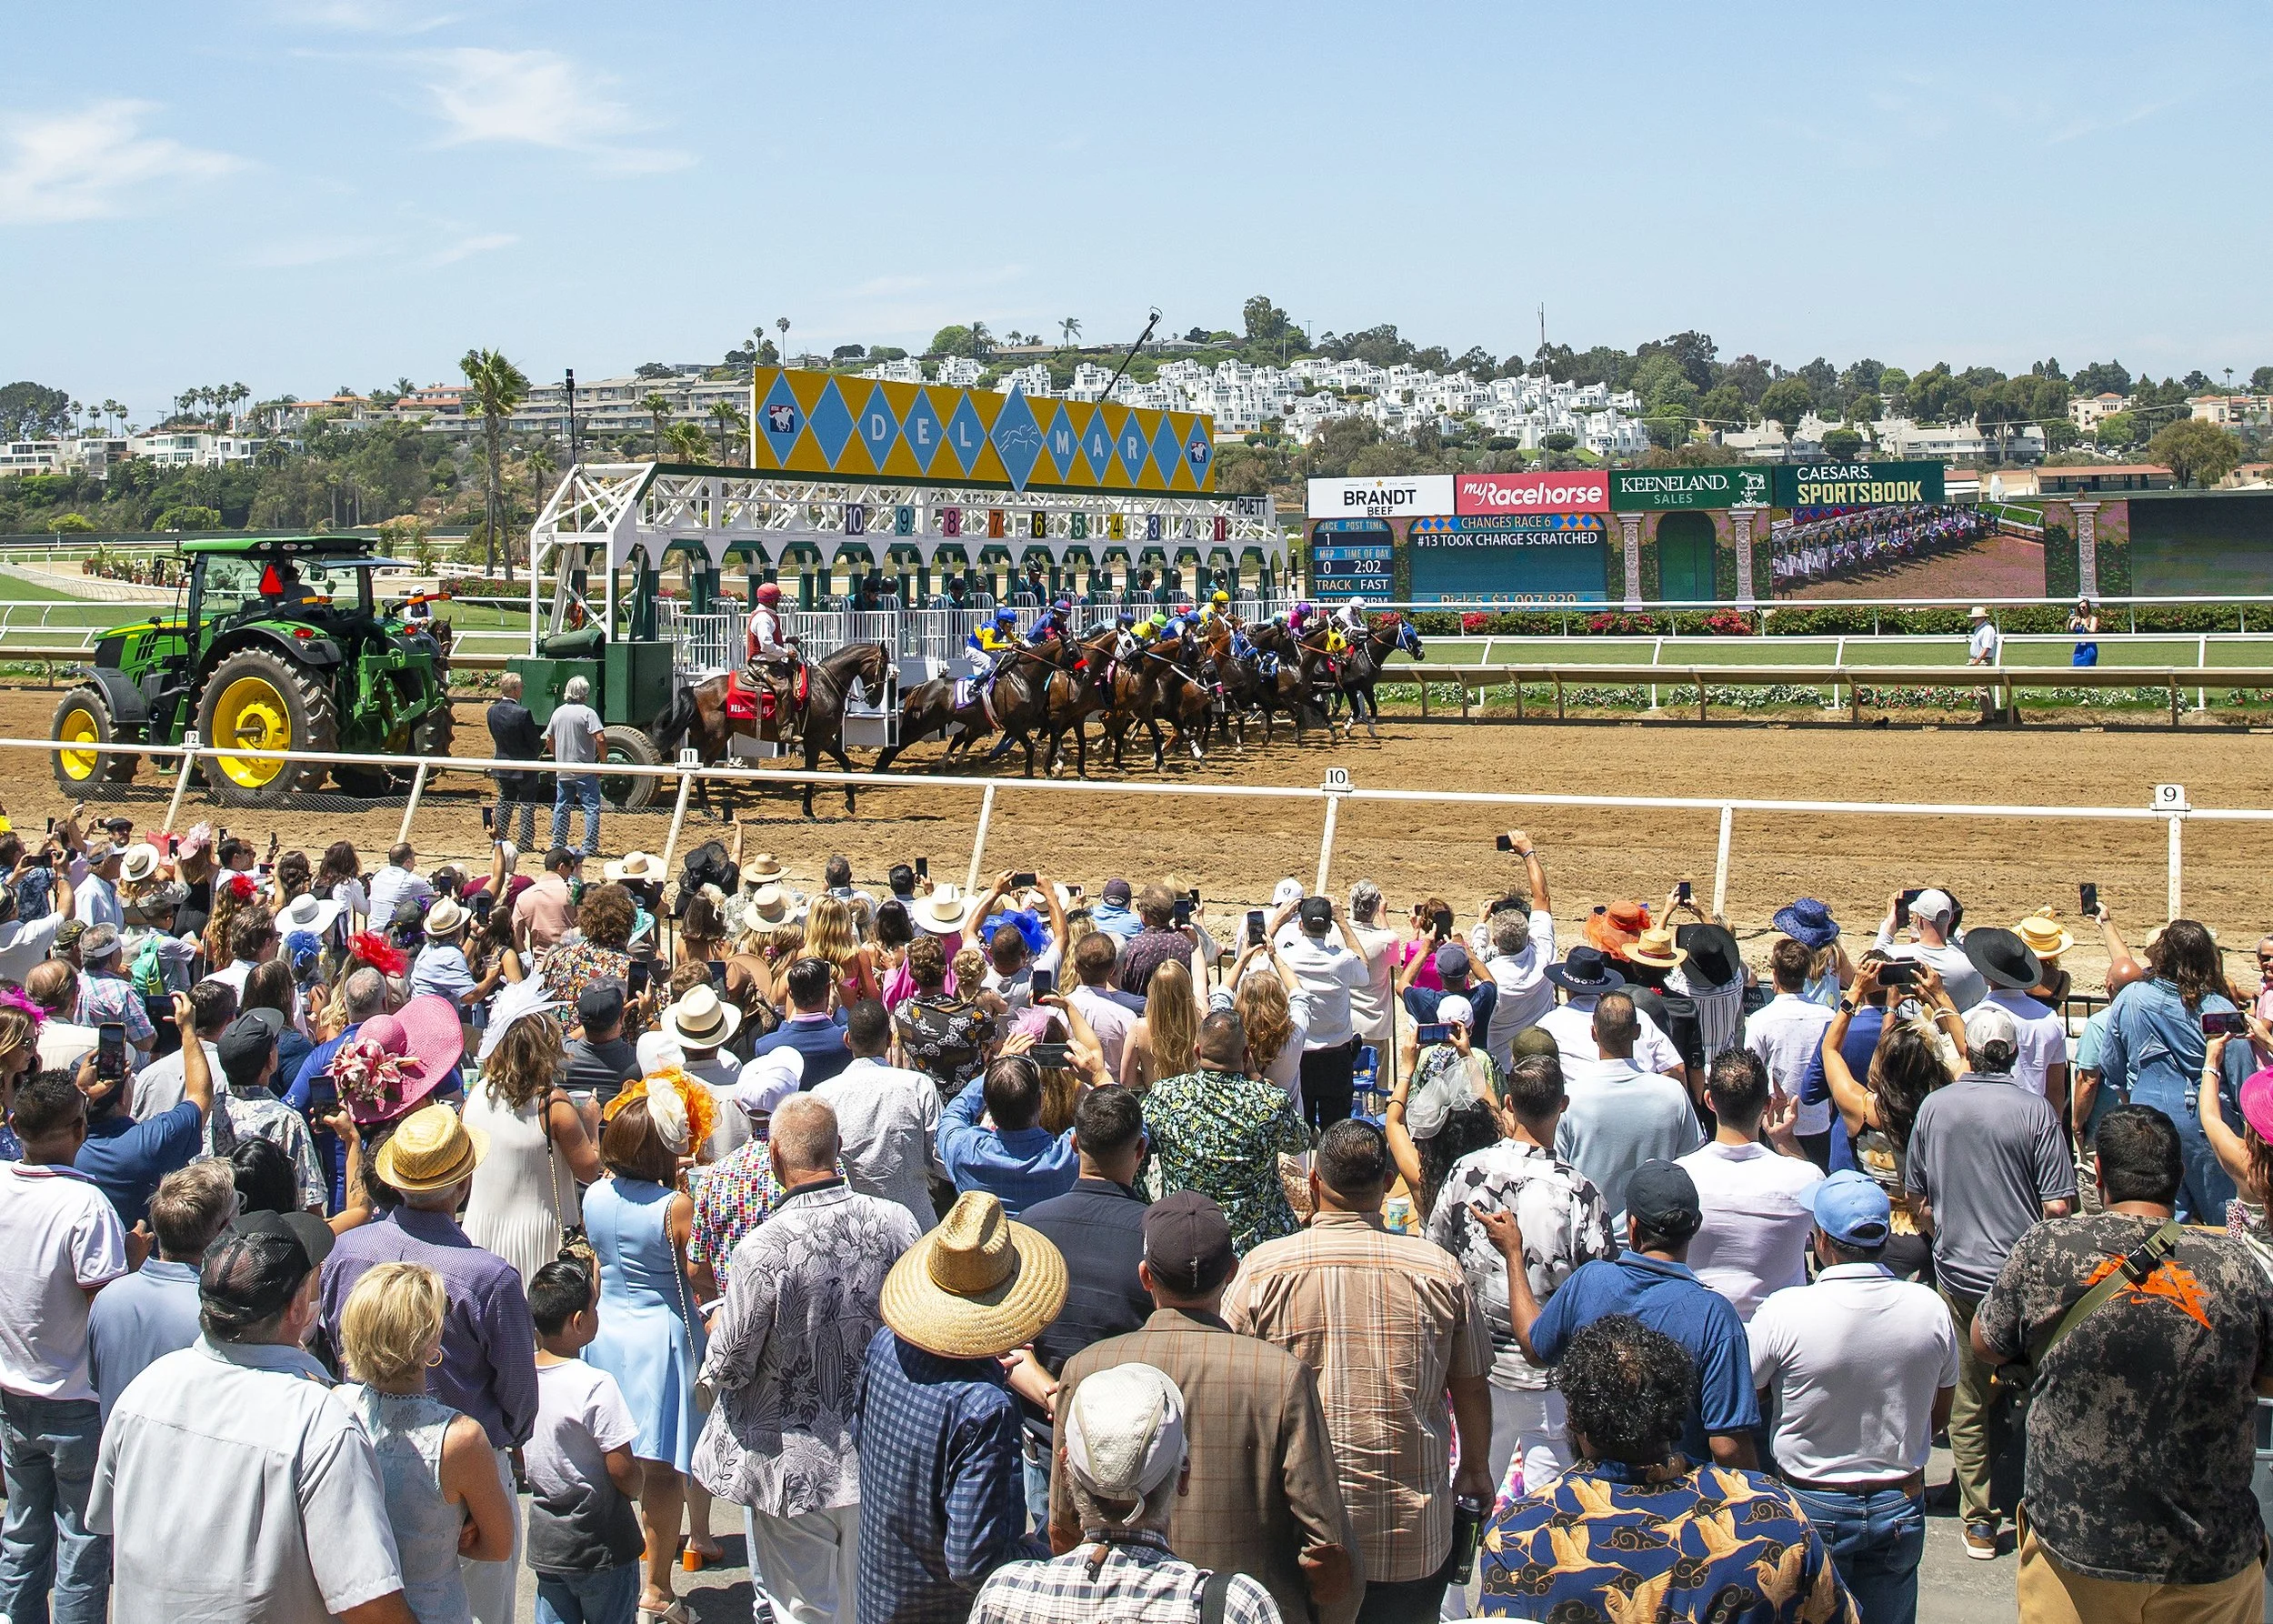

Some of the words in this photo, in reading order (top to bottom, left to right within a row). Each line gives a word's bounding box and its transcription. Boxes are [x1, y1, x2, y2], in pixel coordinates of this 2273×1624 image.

[871, 414, 972, 447] DEL
[1056, 429, 1138, 460] MAR
[1344, 489, 1417, 506] BRANDT
[1463, 482, 1603, 506] myRacehorse
[1654, 493, 1693, 505] SALES
[1797, 480, 1923, 505] SPORTSBOOK
[1237, 497, 1267, 516] PUETT
[846, 506, 863, 533] 10
[899, 508, 909, 533] 9
[947, 510, 956, 534] 8
[992, 512, 1000, 536] 7
[1035, 513, 1043, 536] 6
[1074, 515, 1083, 536] 5
[1112, 516, 1121, 537] 4
[1150, 516, 1158, 538] 3
[1185, 518, 1192, 538] 2
[1320, 521, 1338, 530] RACE
[1346, 521, 1363, 530] POST
[1366, 521, 1383, 530] TIME
[1461, 516, 1512, 529] CHANGES
[1515, 516, 1541, 527] RACE
[1545, 516, 1551, 527] 6
[1325, 533, 1330, 546] 1
[1417, 535, 1438, 546] #13
[1440, 534, 1474, 546] TOOK
[1476, 534, 1524, 546] CHARGE
[1527, 532, 1597, 545] SCRATCHED
[1344, 549, 1361, 558] TIME
[1364, 549, 1373, 558] OF
[1376, 548, 1389, 558] DAY
[1323, 561, 1331, 574] 0
[1354, 560, 1381, 574] 2:02
[1316, 579, 1352, 590] TRACK
[1360, 579, 1388, 590] FAST
[186, 733, 196, 743] 12
[684, 750, 693, 762] 11
[1329, 770, 1346, 784] 10
[2163, 787, 2177, 801] 9
